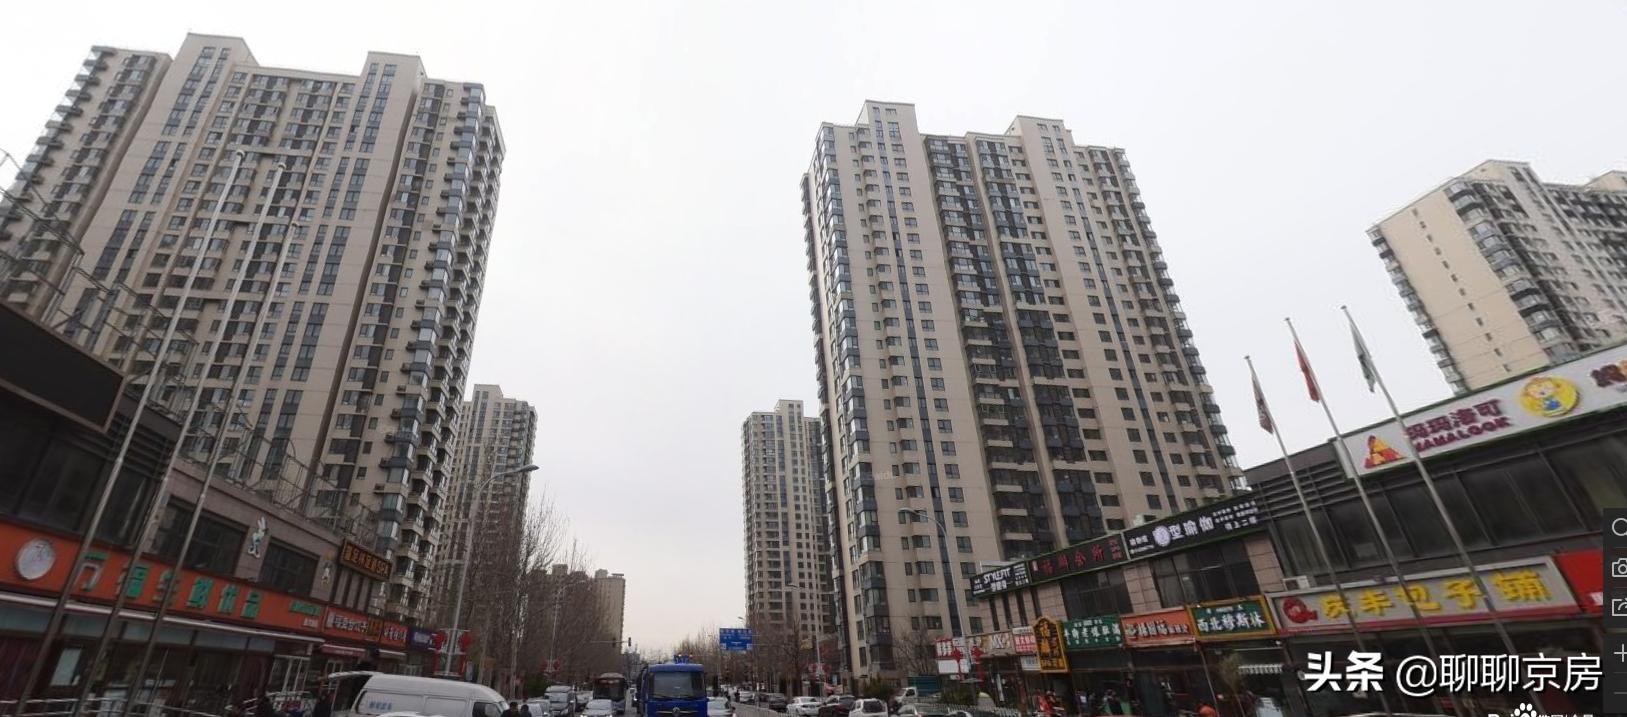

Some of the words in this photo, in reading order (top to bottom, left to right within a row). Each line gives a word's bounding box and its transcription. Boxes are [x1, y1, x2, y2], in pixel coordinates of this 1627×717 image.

[1197, 611, 1266, 632] 西北穆斯林
